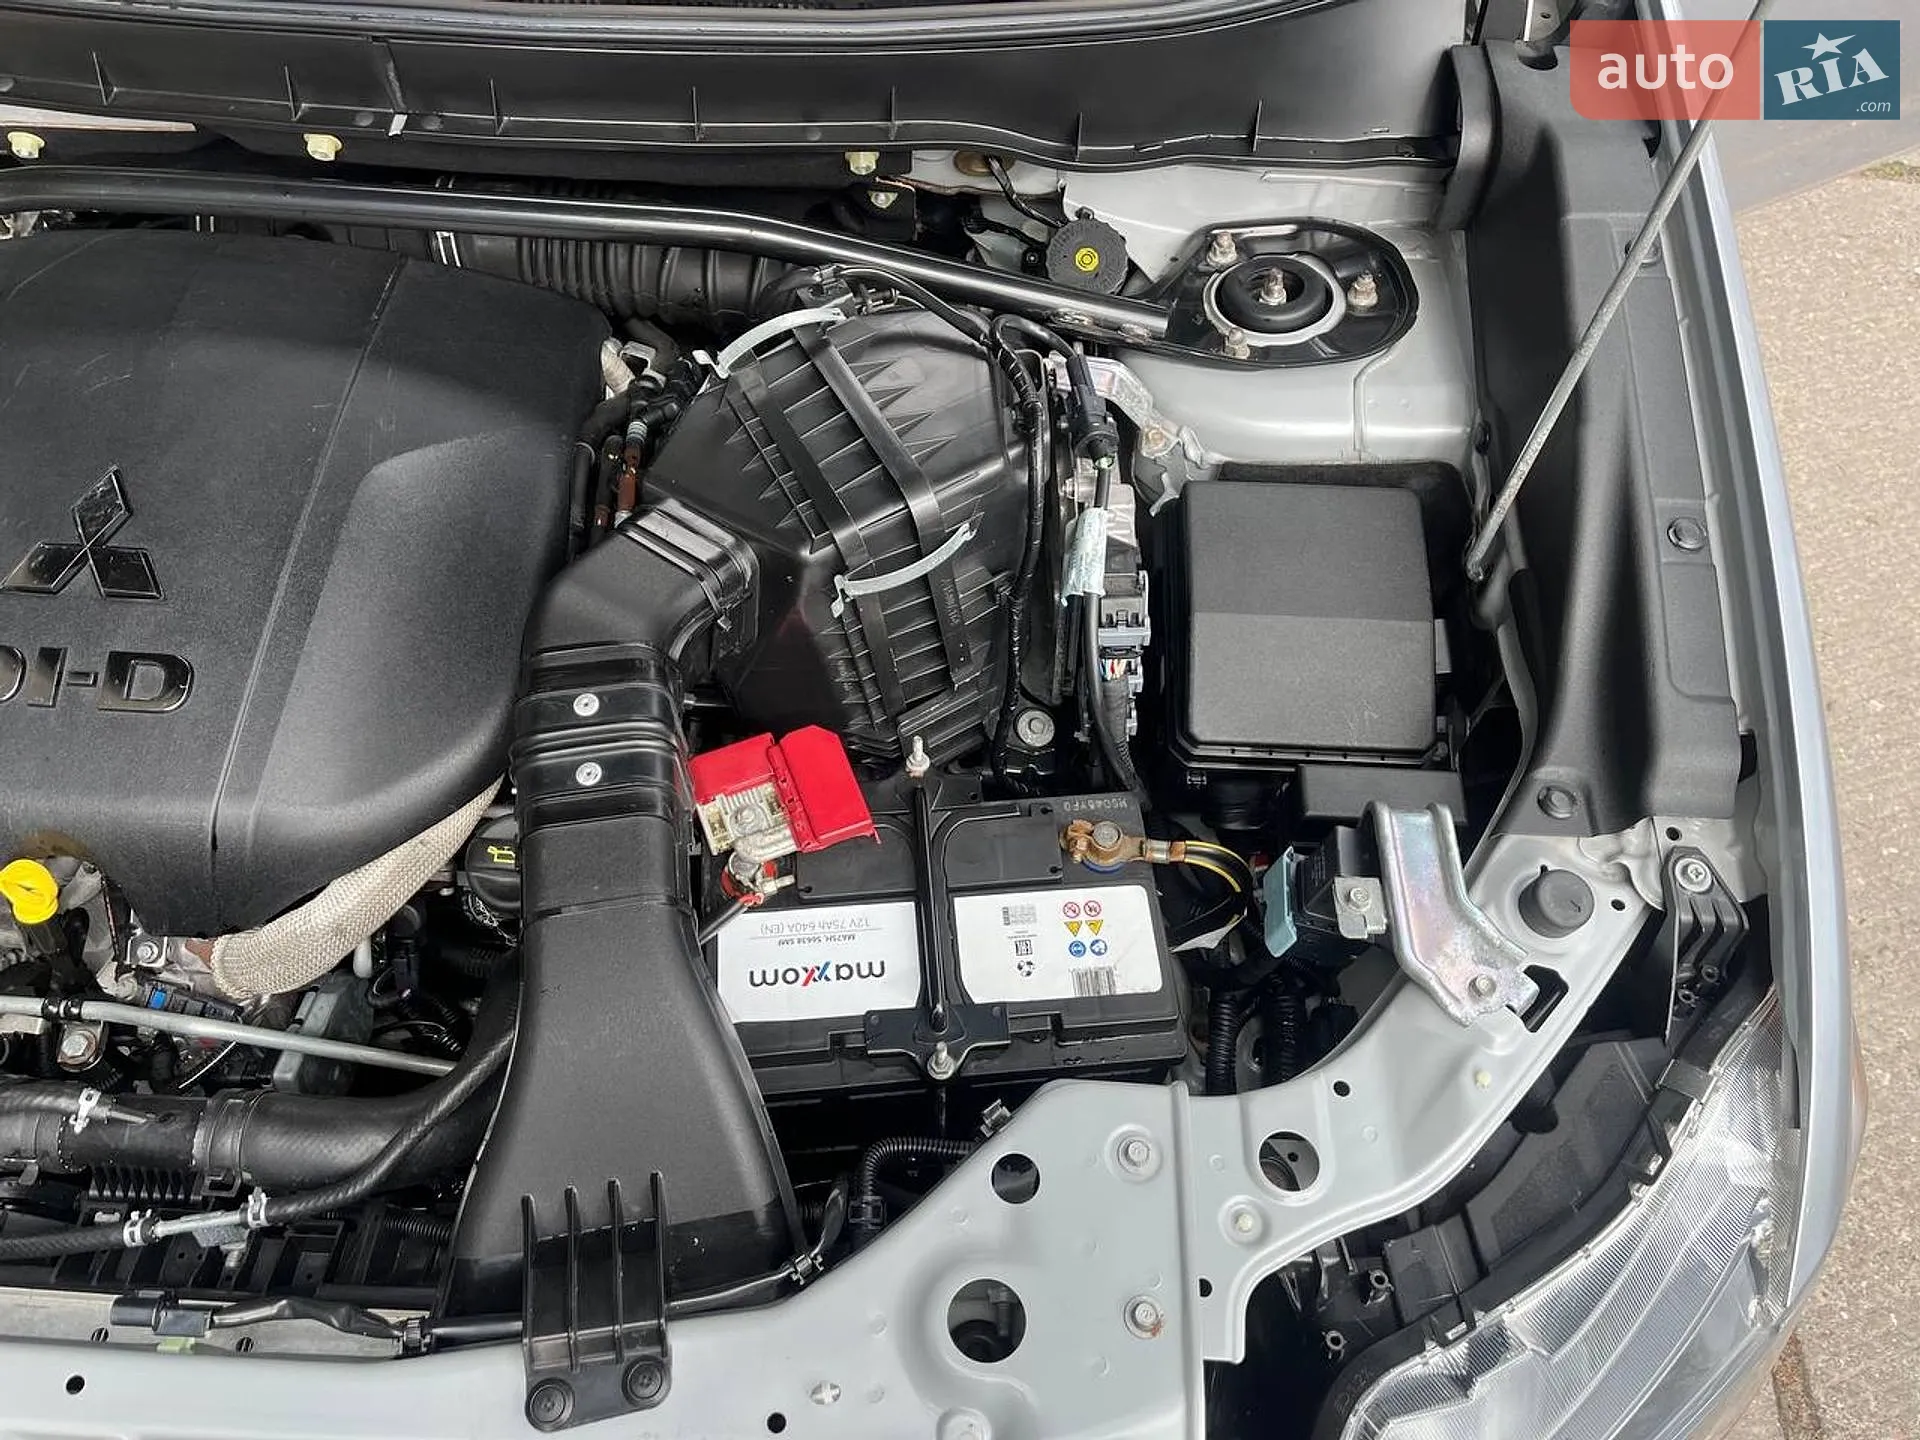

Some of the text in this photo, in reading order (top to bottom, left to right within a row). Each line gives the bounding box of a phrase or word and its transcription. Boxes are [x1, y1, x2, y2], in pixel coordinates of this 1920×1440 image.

[0, 645, 194, 714] I-D
[760, 917, 870, 936] 12V 75Ah 640A (EN)
[749, 960, 885, 986] maxxom
